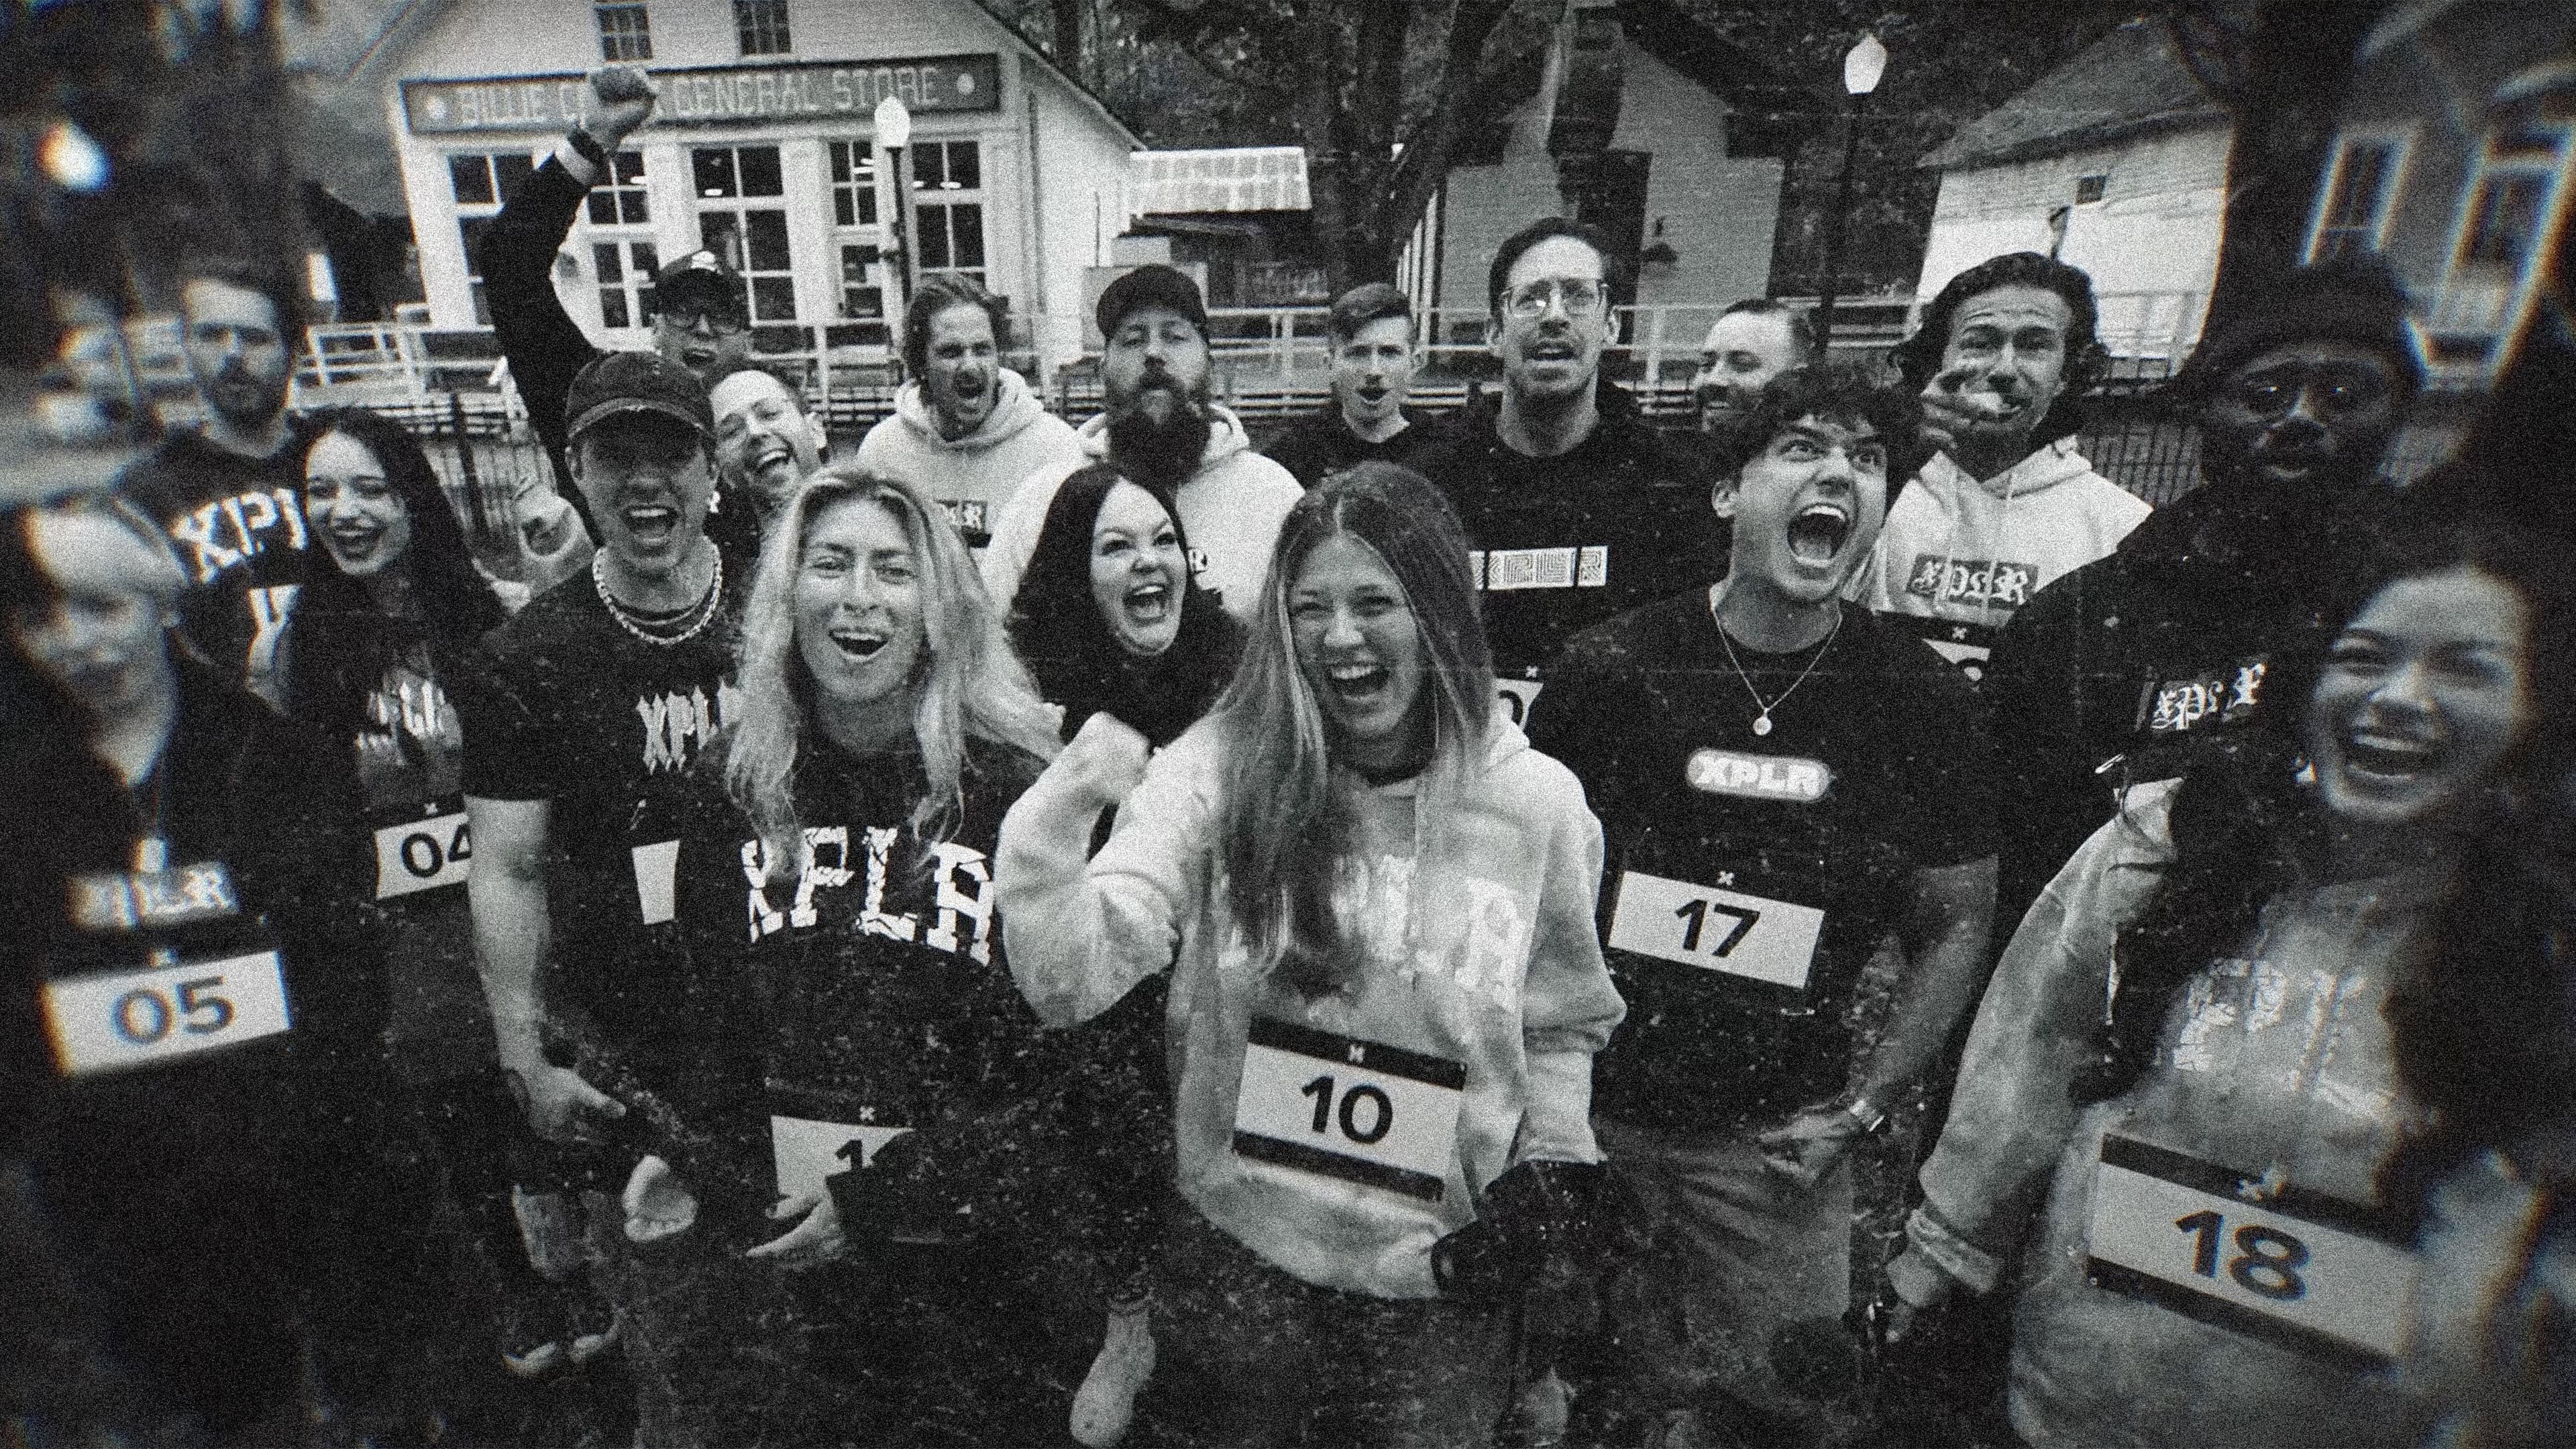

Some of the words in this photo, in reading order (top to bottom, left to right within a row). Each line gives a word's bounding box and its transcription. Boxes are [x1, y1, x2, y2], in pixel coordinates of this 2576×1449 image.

[674, 73, 820, 115] GENERAL
[832, 66, 939, 110] STORE
[1694, 755, 1819, 796] XPLR
[400, 824, 472, 878] 04
[1675, 898, 1761, 958] 17
[111, 975, 235, 1046] 05
[1301, 1075, 1393, 1145] 10
[835, 1139, 863, 1172] 1
[2175, 1210, 2310, 1300] 18
